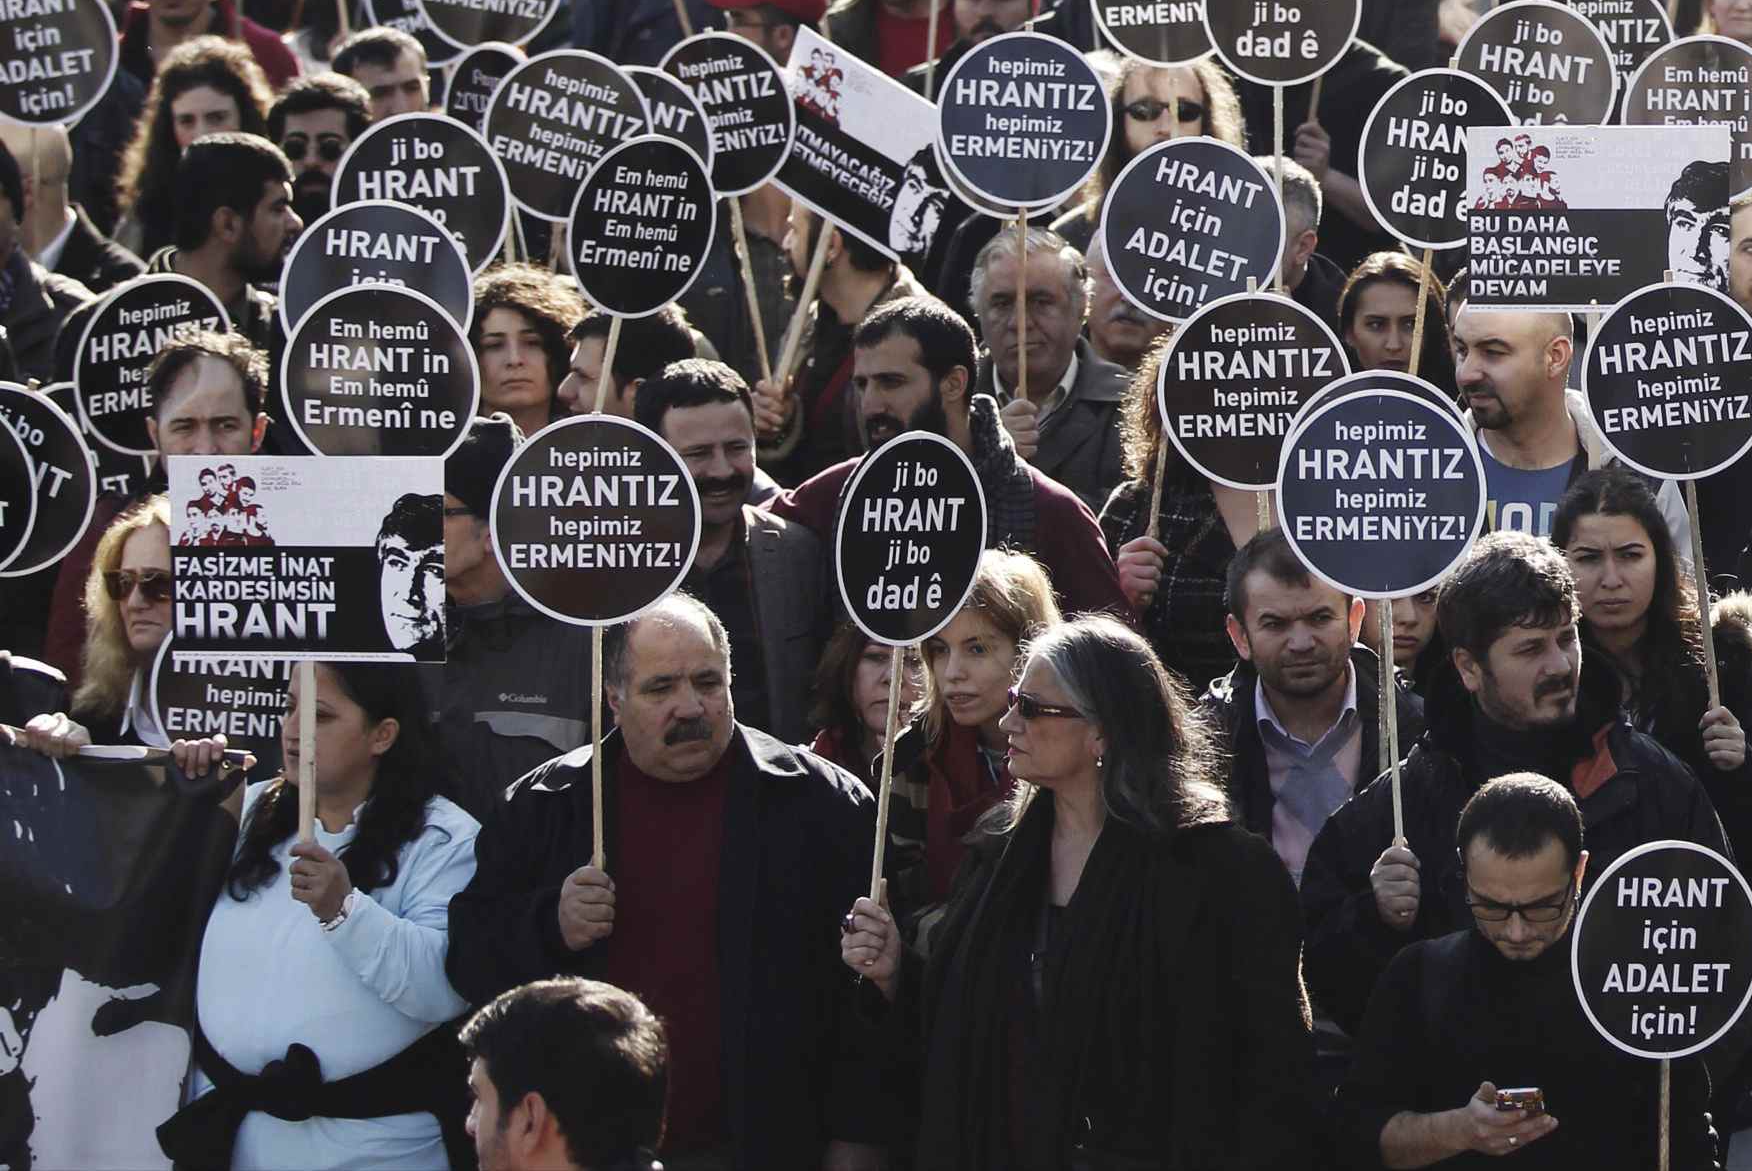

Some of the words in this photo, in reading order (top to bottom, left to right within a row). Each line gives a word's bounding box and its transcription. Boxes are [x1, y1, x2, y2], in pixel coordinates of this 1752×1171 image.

[989, 56, 1065, 78] hepimiz
[956, 79, 1096, 110] HRANTIZ
[986, 113, 1063, 135] hepimiz
[1470, 216, 1500, 232] BU
[1508, 216, 1570, 233] DAHA
[1471, 255, 1621, 275] MÜCADELEYE
[1471, 280, 1547, 296] DEVAM
[330, 318, 362, 338] Em
[369, 320, 428, 340] hemû
[310, 343, 414, 372] HRANT
[424, 348, 449, 373] in
[330, 376, 363, 395] Em
[369, 377, 428, 397] hemû
[304, 399, 413, 428] Ermenî
[421, 410, 455, 429] ne
[1335, 420, 1426, 445] hepimiz
[550, 446, 641, 471] hepimiz
[1299, 448, 1464, 480] HRANTIZ
[513, 475, 679, 506] HRANTIZ
[893, 462, 908, 492] ji
[914, 462, 937, 486] bo
[862, 498, 965, 532] HRANT
[1336, 488, 1426, 513] hepimiz
[550, 515, 642, 540] hepimiz
[885, 546, 900, 571] ji
[906, 540, 930, 564] bo
[867, 576, 919, 609] dad
[926, 573, 942, 609] ê
[176, 602, 336, 637] HRANT
[1617, 877, 1729, 907] HRANT
[1643, 920, 1696, 954] için
[1602, 963, 1730, 993] ADALET
[1631, 1005, 1696, 1040] için!
